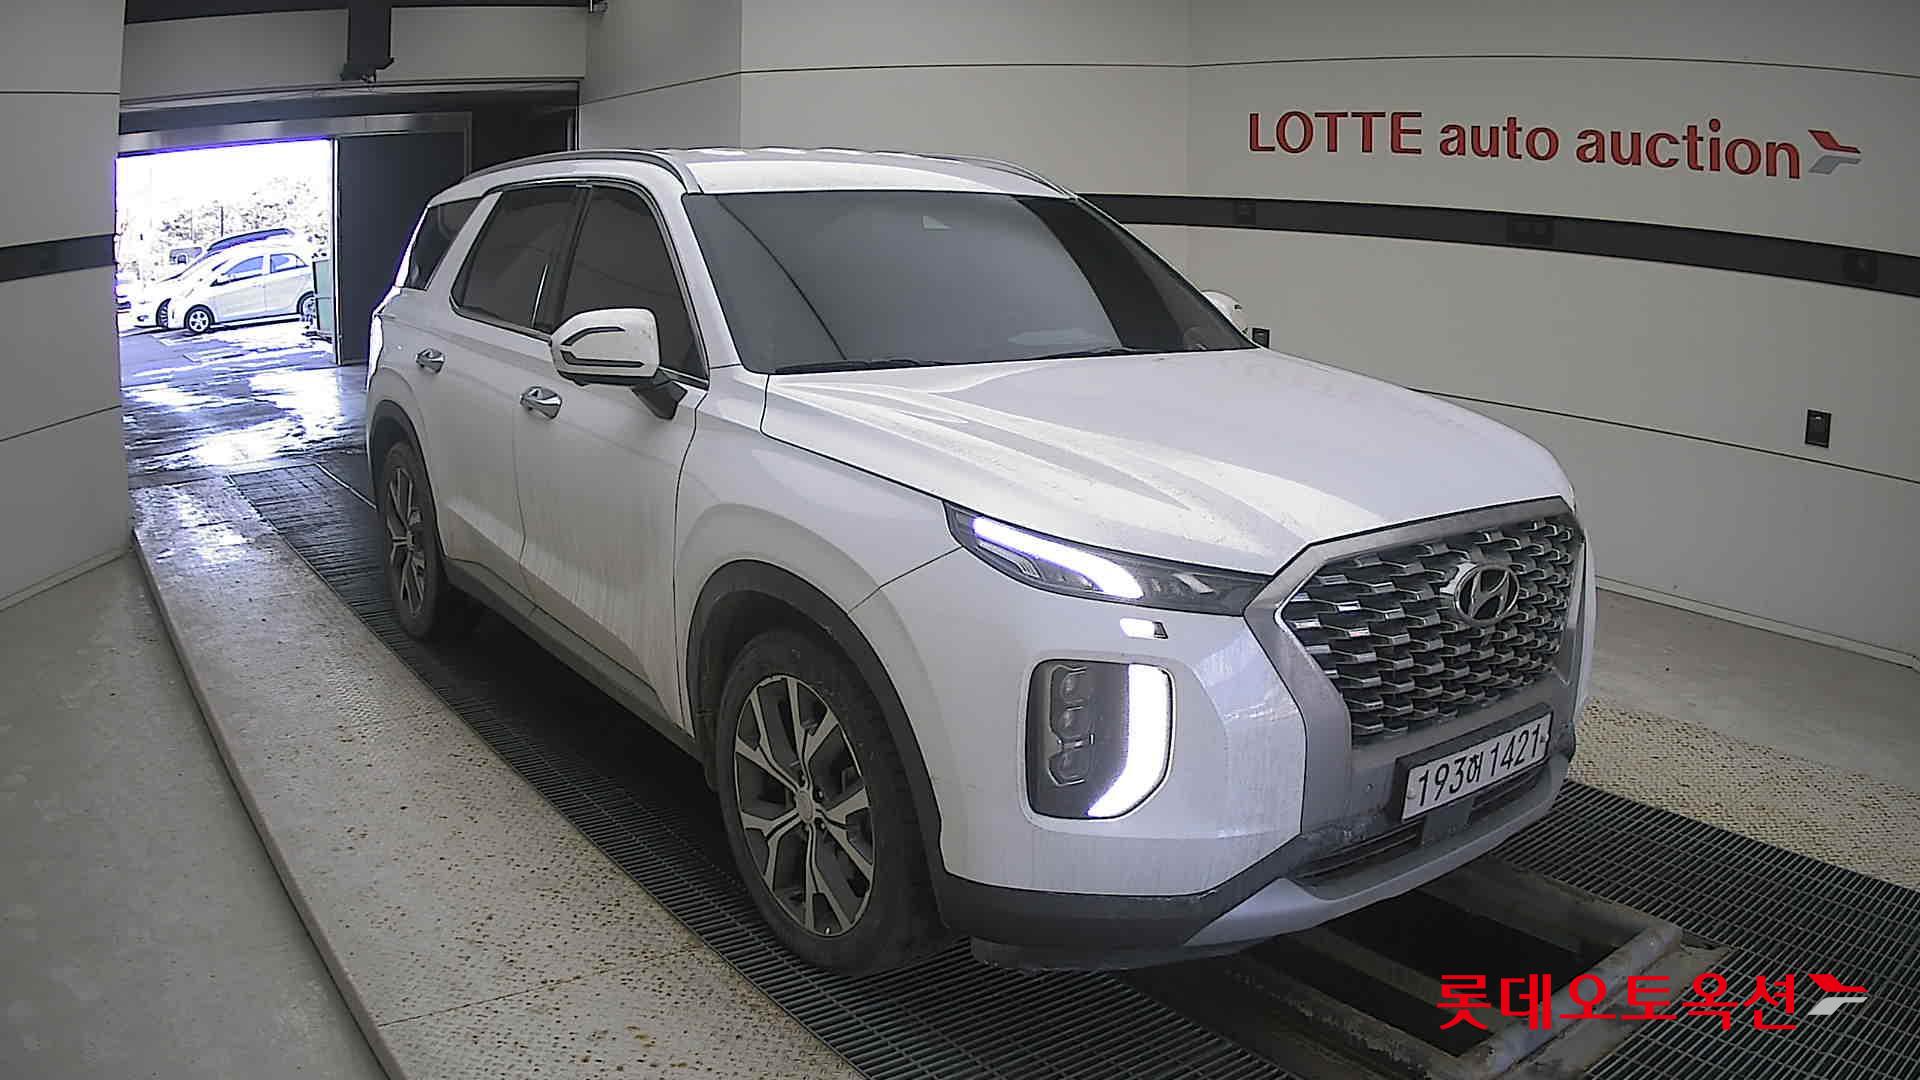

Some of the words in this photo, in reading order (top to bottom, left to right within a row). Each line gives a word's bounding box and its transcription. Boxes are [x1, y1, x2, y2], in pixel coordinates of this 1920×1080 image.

[1248, 111, 1422, 154] LOTTE
[1439, 116, 1559, 161] auto
[1575, 118, 1801, 179] auction
